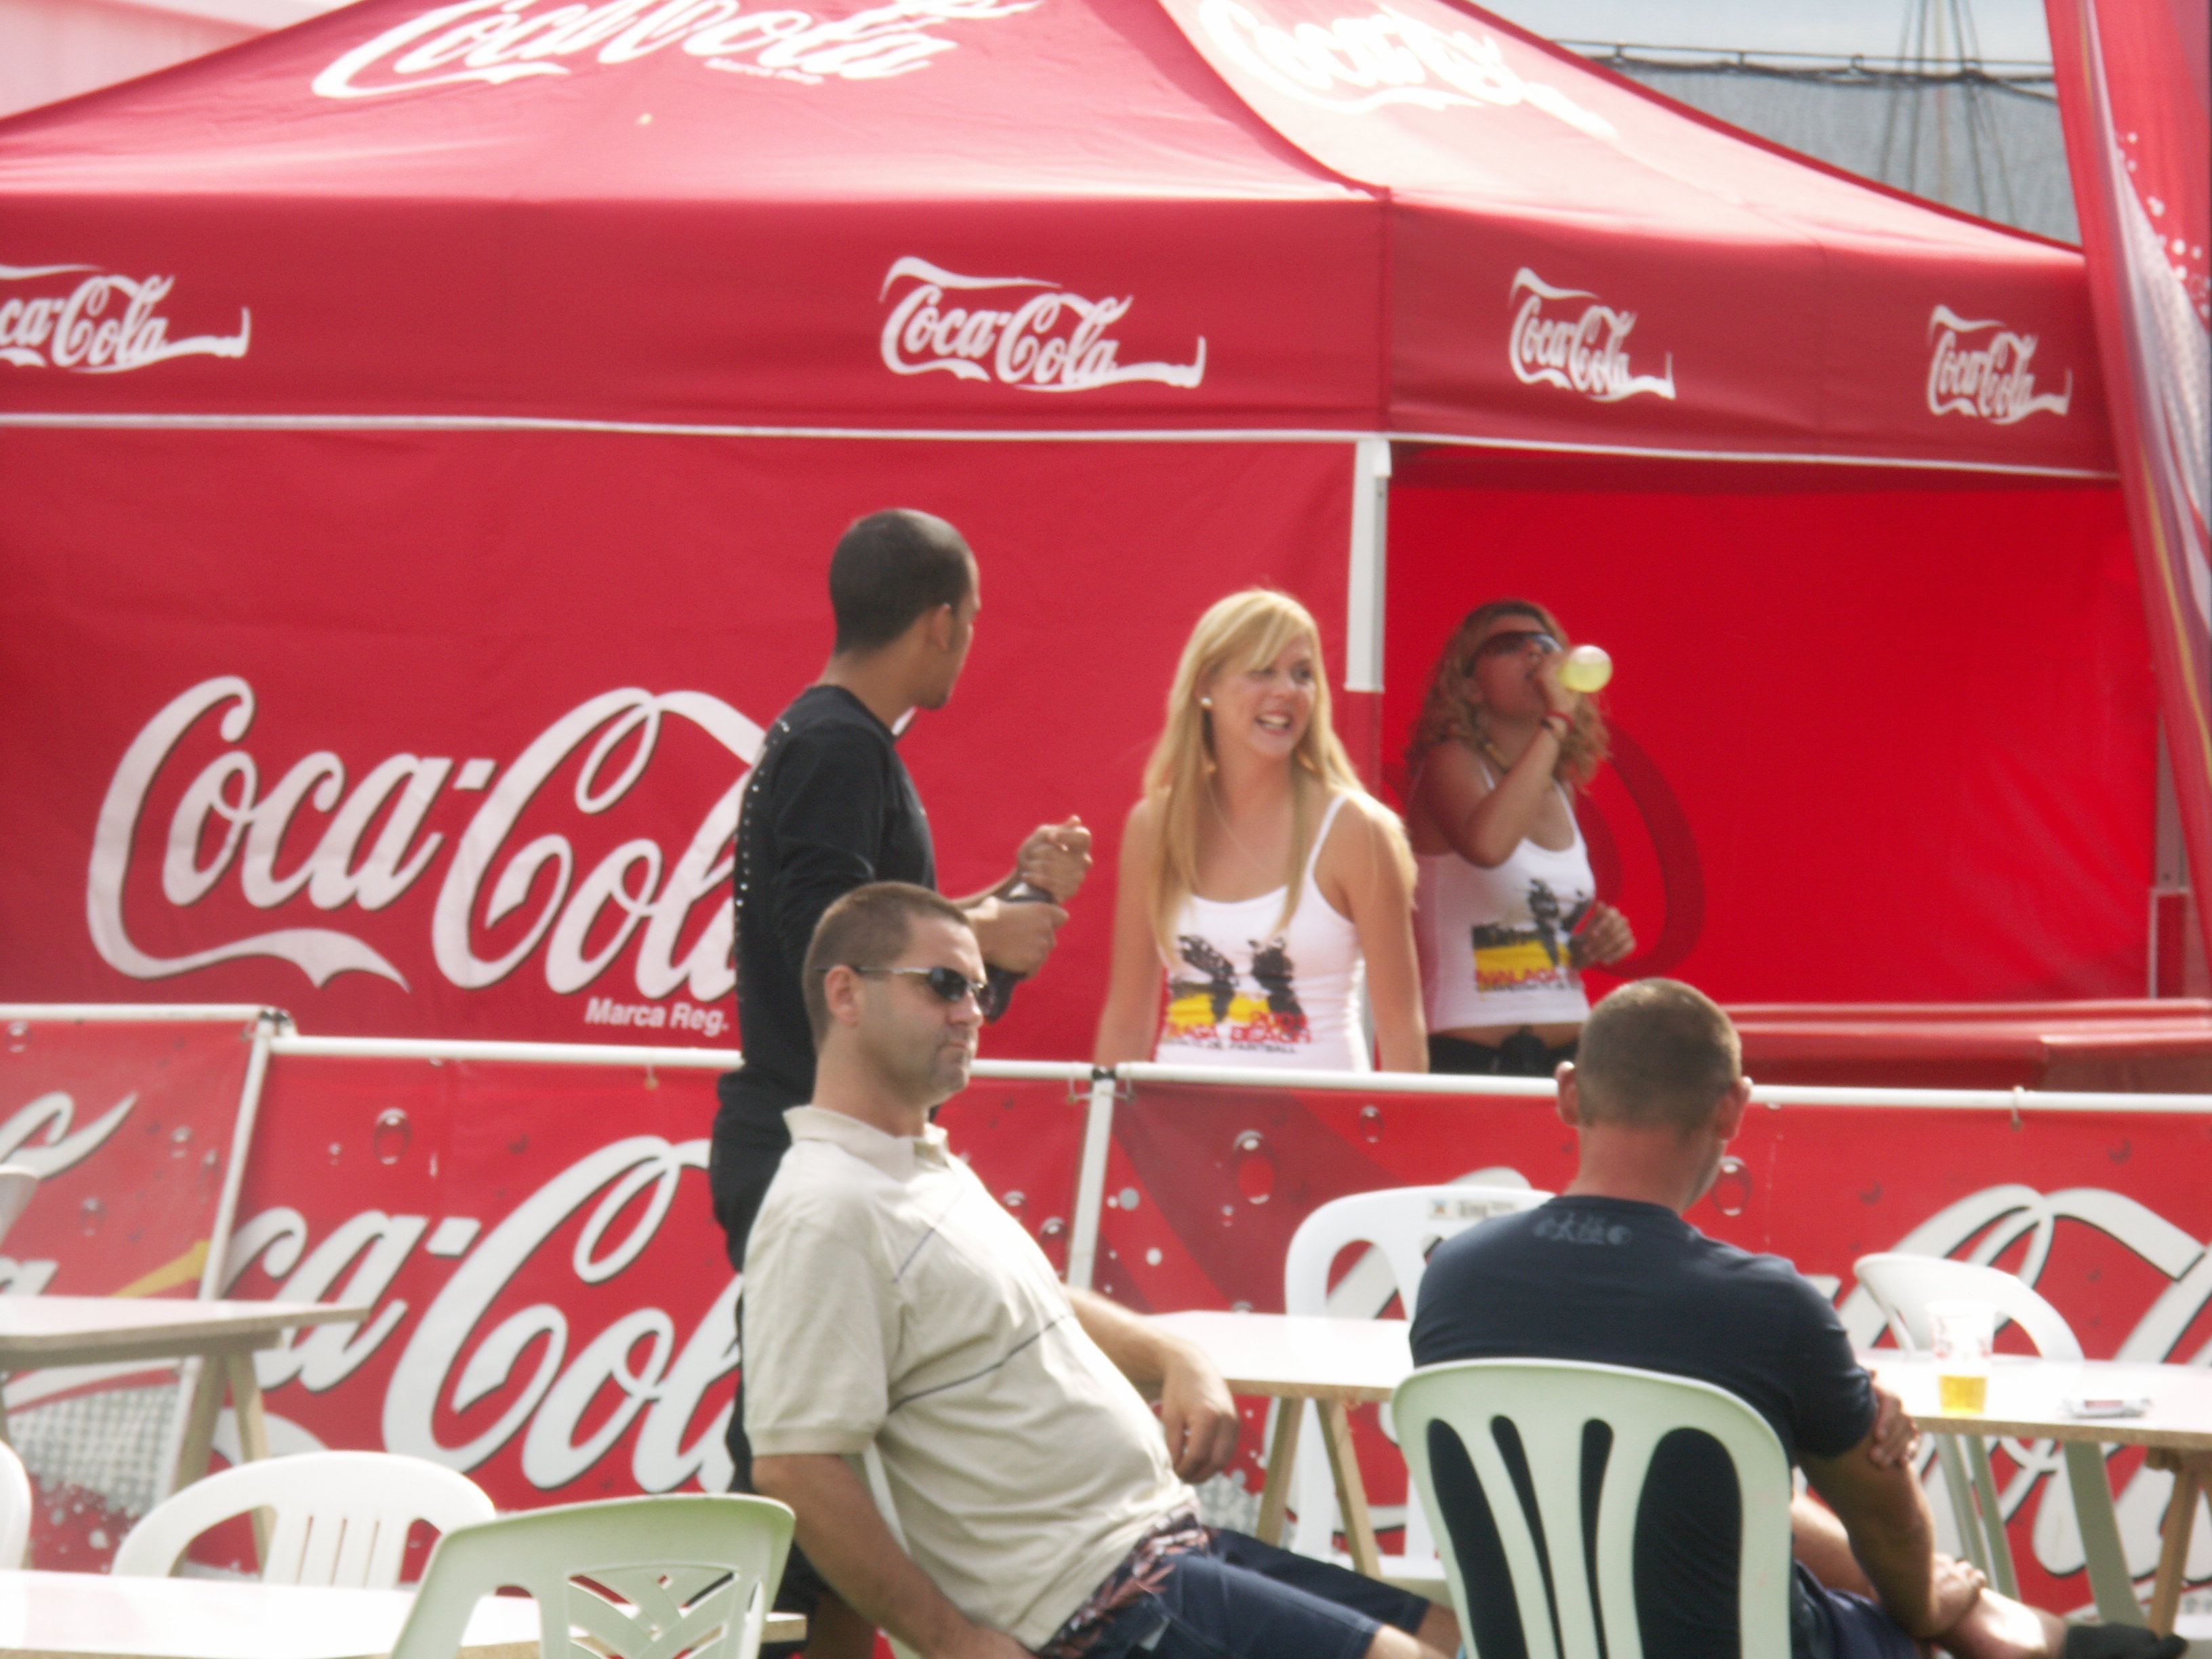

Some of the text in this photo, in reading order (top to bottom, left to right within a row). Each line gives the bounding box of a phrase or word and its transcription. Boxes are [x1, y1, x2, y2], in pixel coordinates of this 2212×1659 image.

[0, 270, 251, 373] ca-Cola
[880, 268, 1205, 392] Coca-Cola
[1509, 278, 1676, 402] Coca-Cola
[1927, 314, 2072, 425] Coca-Cola
[585, 998, 730, 1037] Marca Reg.
